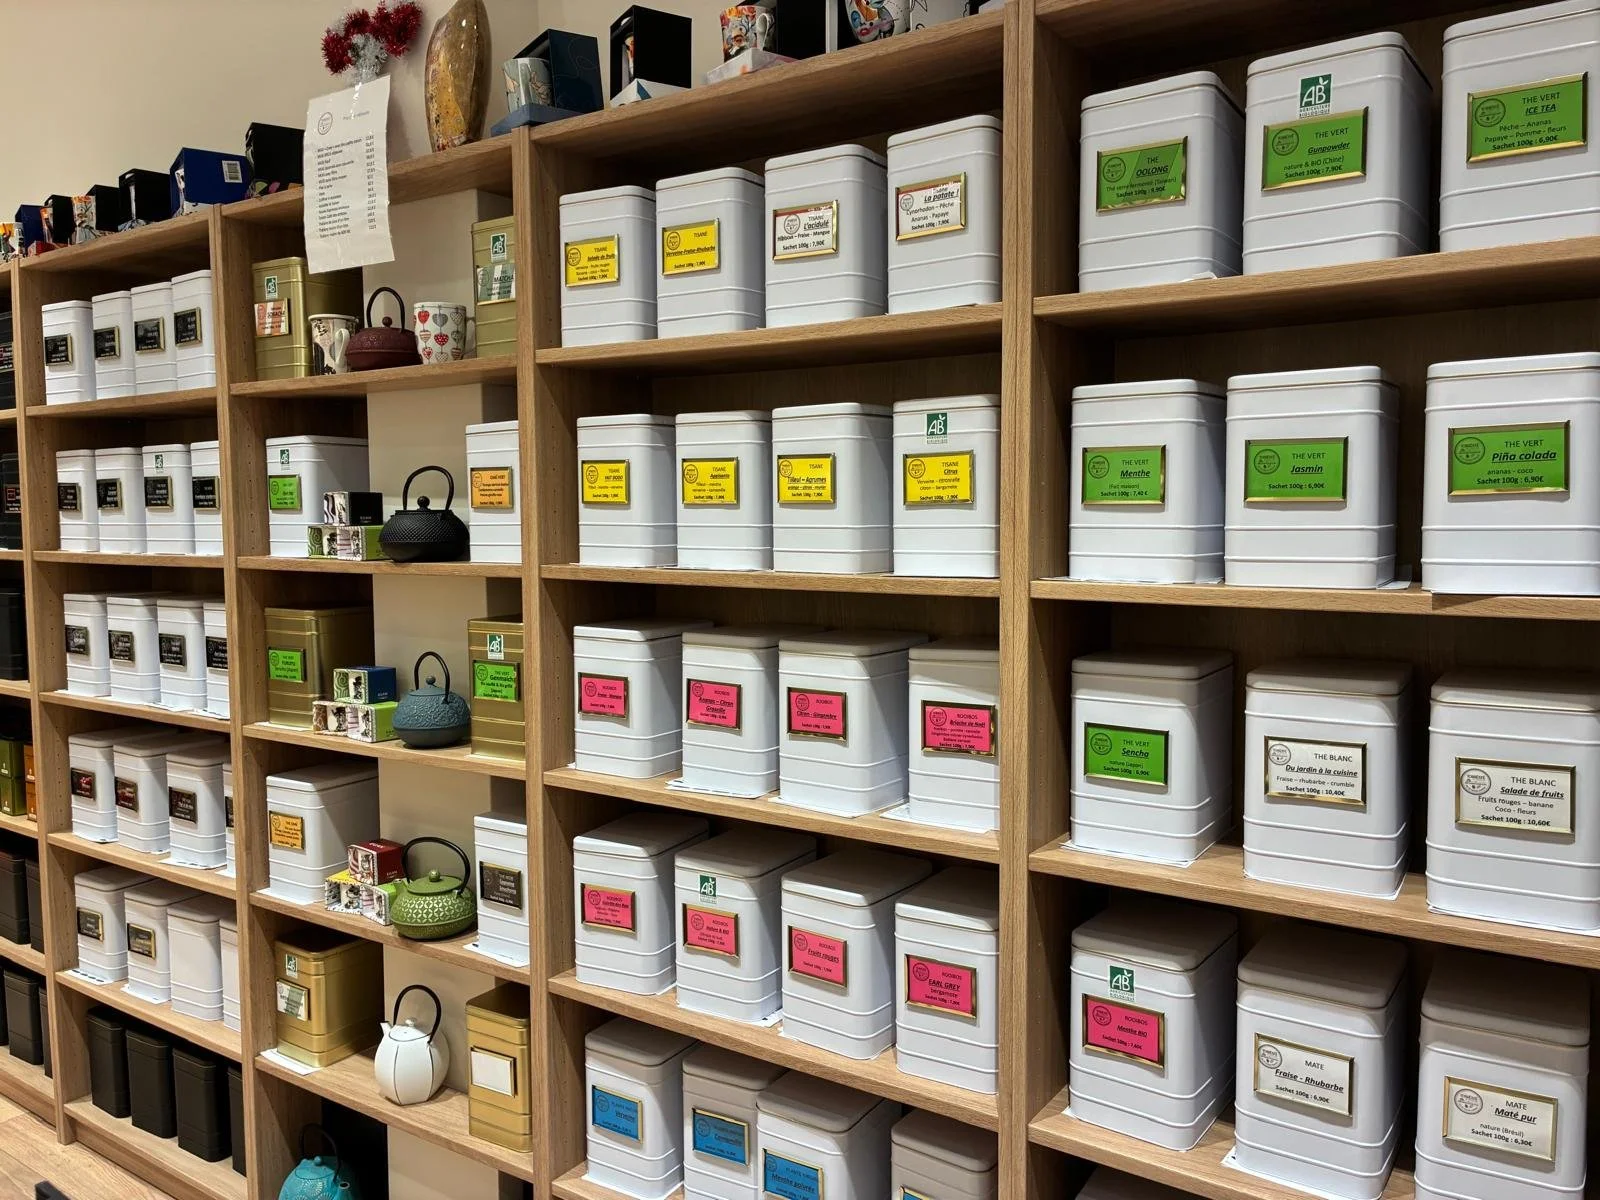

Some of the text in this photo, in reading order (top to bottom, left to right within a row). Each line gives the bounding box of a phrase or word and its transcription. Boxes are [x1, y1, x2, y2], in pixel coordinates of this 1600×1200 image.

[1302, 86, 1325, 106] AB
[1522, 92, 1560, 104] THE VERT
[1299, 109, 1329, 118] BIOLOGIQUE
[1526, 104, 1556, 115] ICE TEA
[1499, 120, 1551, 132] Pêche Ananas
[1315, 128, 1348, 139] THE VERT
[1485, 125, 1566, 144] Papaye Pomme fleurs
[1308, 142, 1349, 154] Gunpowder
[1492, 135, 1558, 151] Sachet 100g 6,90€
[1323, 156, 1344, 165] (Chine)
[1136, 165, 1168, 177] OOLONG
[1285, 168, 1320, 179] Sachet 100g
[933, 192, 954, 201] patate
[911, 211, 949, 222] Ananas Papaye
[803, 220, 829, 230] L'acidulé
[813, 229, 830, 237] Mangue
[493, 242, 504, 253] AB
[928, 420, 944, 434] AB
[1492, 450, 1557, 462] Piña colada
[1120, 469, 1150, 478] Menthe
[1291, 465, 1323, 474] Jasmin
[492, 640, 502, 652] AB
[1122, 748, 1149, 757] Sencha
[1314, 753, 1327, 761] THE
[1296, 765, 1317, 774] jardin
[1299, 777, 1326, 785] rhubarbe
[1329, 780, 1354, 788] crumble
[1511, 777, 1556, 786] THE BLANC
[1307, 787, 1320, 795] 100g
[1326, 789, 1345, 797] 10,40€
[1500, 786, 1528, 795] Salade
[1541, 790, 1564, 799] fruits
[1499, 798, 1521, 806] rouges
[1528, 800, 1554, 808] banane
[1481, 814, 1503, 822] Sachet
[701, 883, 714, 895] AB
[929, 979, 960, 991] EARL GREY
[1112, 975, 1130, 991] AB
[931, 988, 958, 998] bergamote
[1125, 1016, 1148, 1026] ROOIBOS
[1117, 1025, 1136, 1036] Menthe
[1102, 1034, 1116, 1042] Sachet
[1305, 1060, 1324, 1070] MATE
[1275, 1068, 1344, 1092] Fraise Rhubarbe
[1275, 1085, 1329, 1103] Sachet 100g 6,90€
[1506, 1100, 1527, 1110] MATE
[1495, 1107, 1537, 1124] Maté pur
[1471, 1128, 1509, 1142] Sachet 100g
[1480, 1123, 1524, 1138] nature (Brésil)
